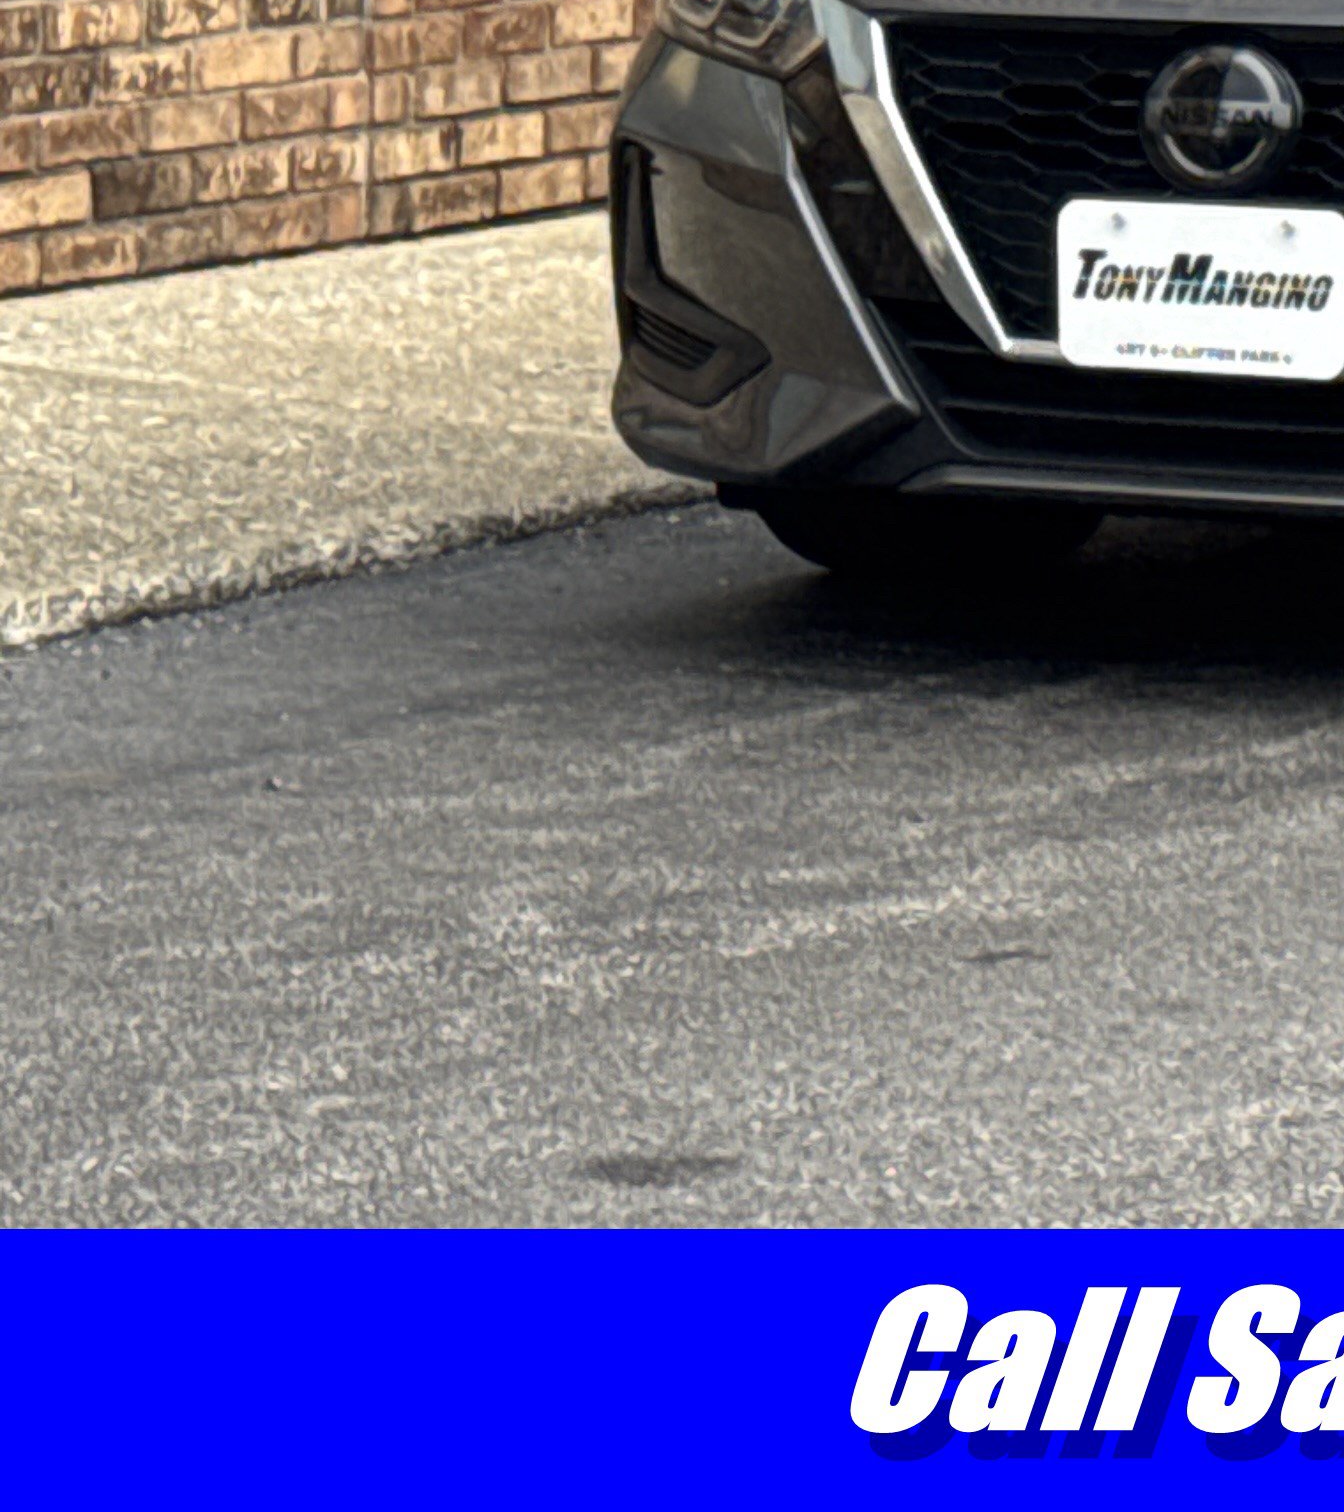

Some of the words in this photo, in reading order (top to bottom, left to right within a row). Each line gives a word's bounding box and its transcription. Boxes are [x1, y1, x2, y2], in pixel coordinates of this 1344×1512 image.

[1159, 101, 1276, 128] NISSAN
[1072, 248, 1165, 303] TONY
[1160, 253, 1335, 312] MANGINO
